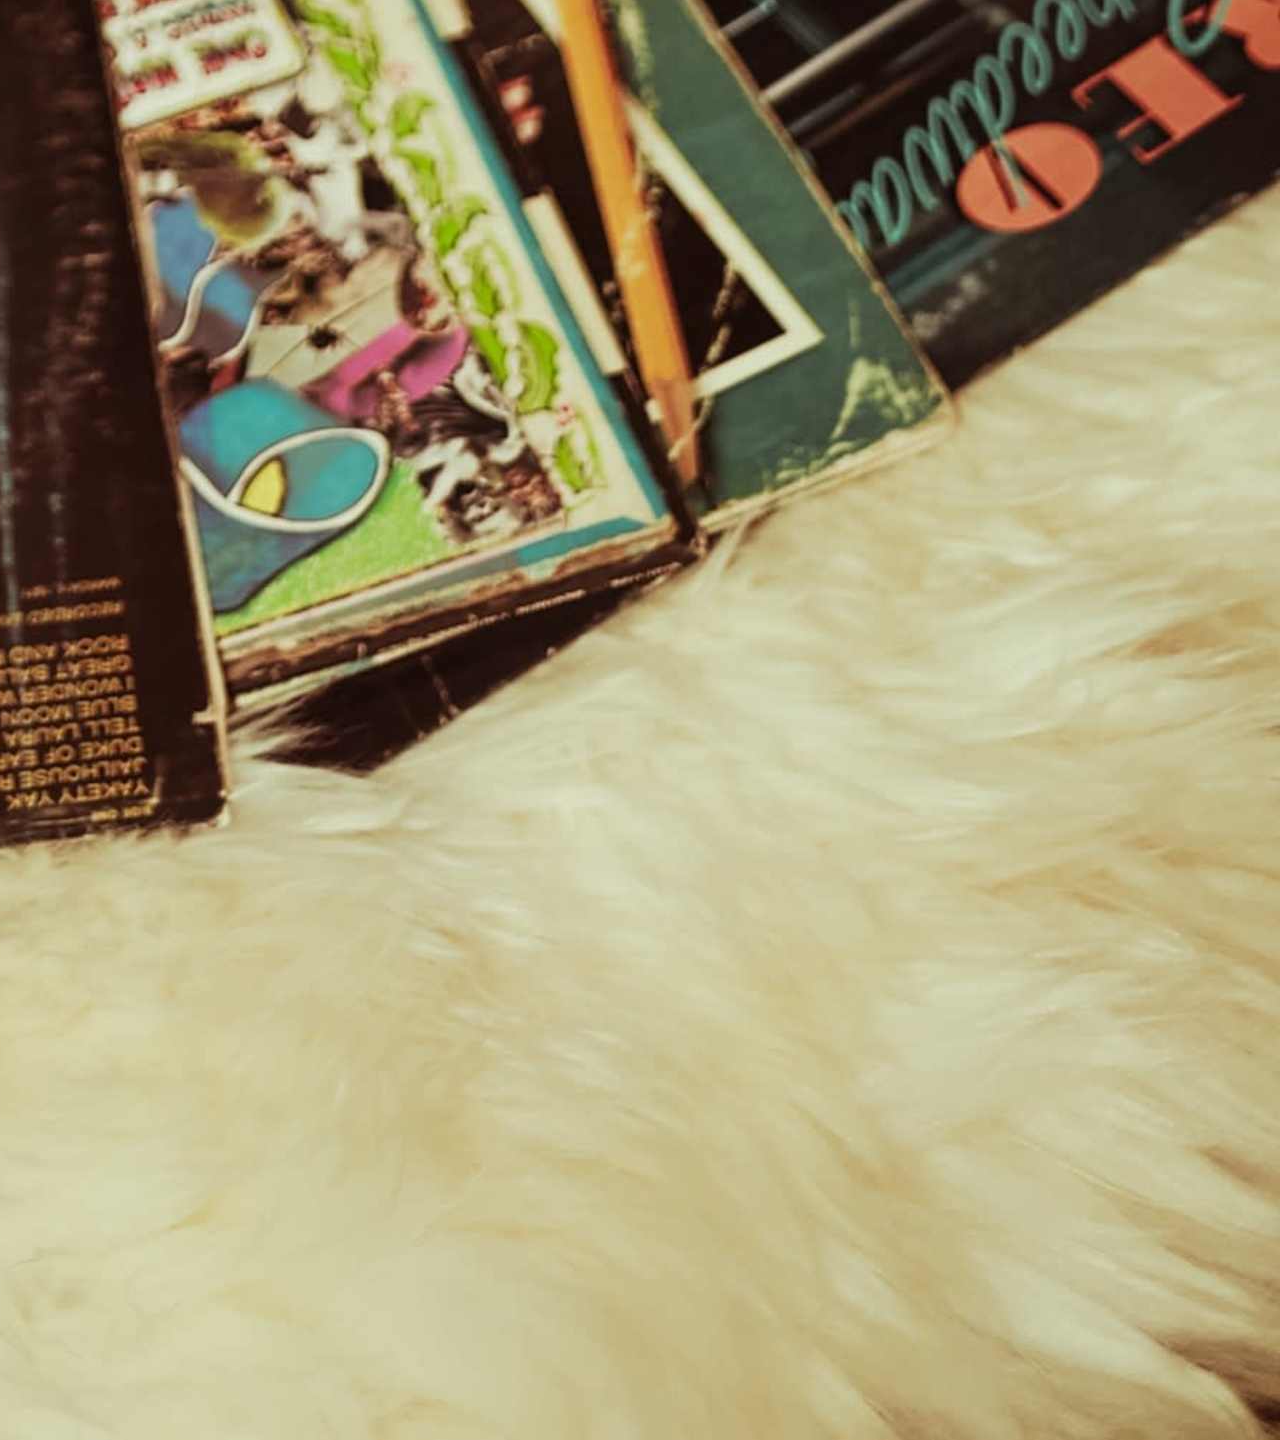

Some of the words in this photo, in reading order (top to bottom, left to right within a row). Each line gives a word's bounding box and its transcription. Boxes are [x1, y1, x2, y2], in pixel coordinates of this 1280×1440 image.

[9, 643, 57, 665] AND
[62, 634, 128, 657] ROCK
[56, 655, 131, 680] GREAT
[20, 677, 123, 704] WONDER
[0, 705, 73, 726] MOON
[77, 694, 137, 718] BLUE
[3, 722, 79, 747] LAURA
[82, 716, 142, 736] TELL
[45, 744, 75, 763] OF
[80, 736, 144, 759] DUKE
[19, 757, 147, 789] JAILHOUSE
[4, 790, 53, 811] YAK
[60, 779, 150, 805] YAKETY
